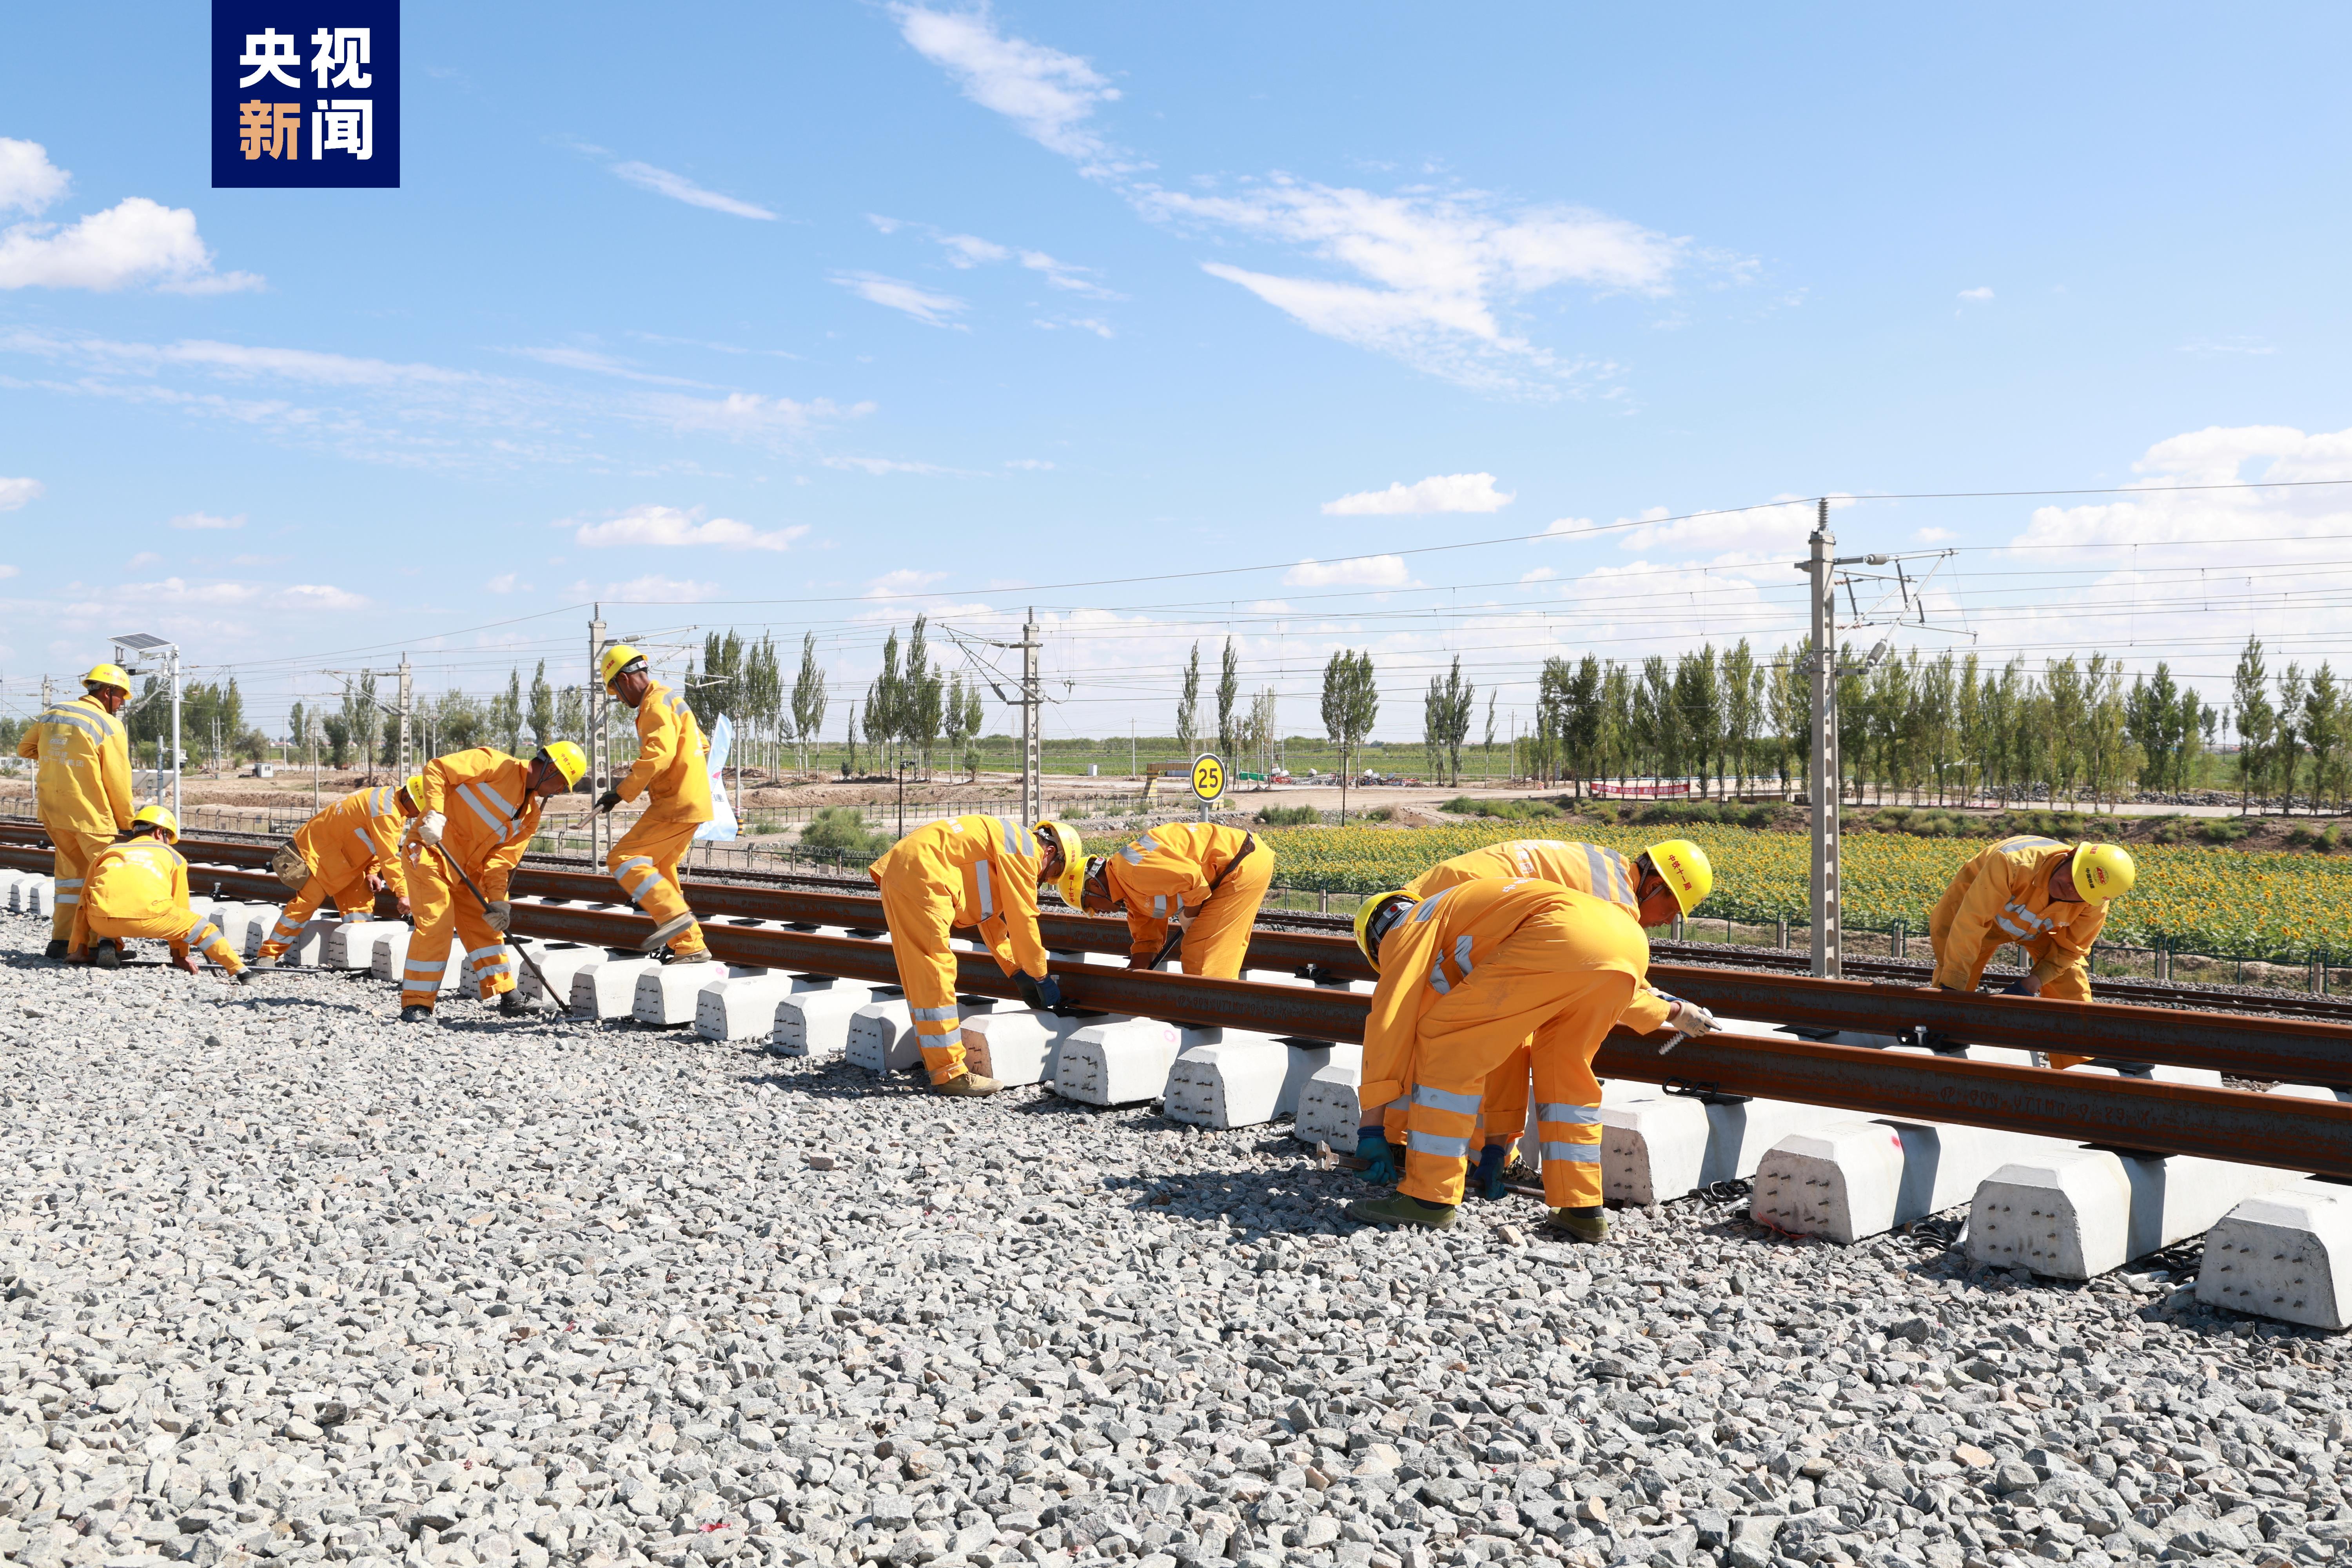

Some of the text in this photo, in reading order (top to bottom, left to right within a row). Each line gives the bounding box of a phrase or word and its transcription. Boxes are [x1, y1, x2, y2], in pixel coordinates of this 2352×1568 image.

[561, 753, 576, 775] 中铁十一局
[1199, 768, 1218, 788] 25
[1668, 855, 1692, 891] 中铁十一局
[2085, 867, 2095, 889] 中国铁建
